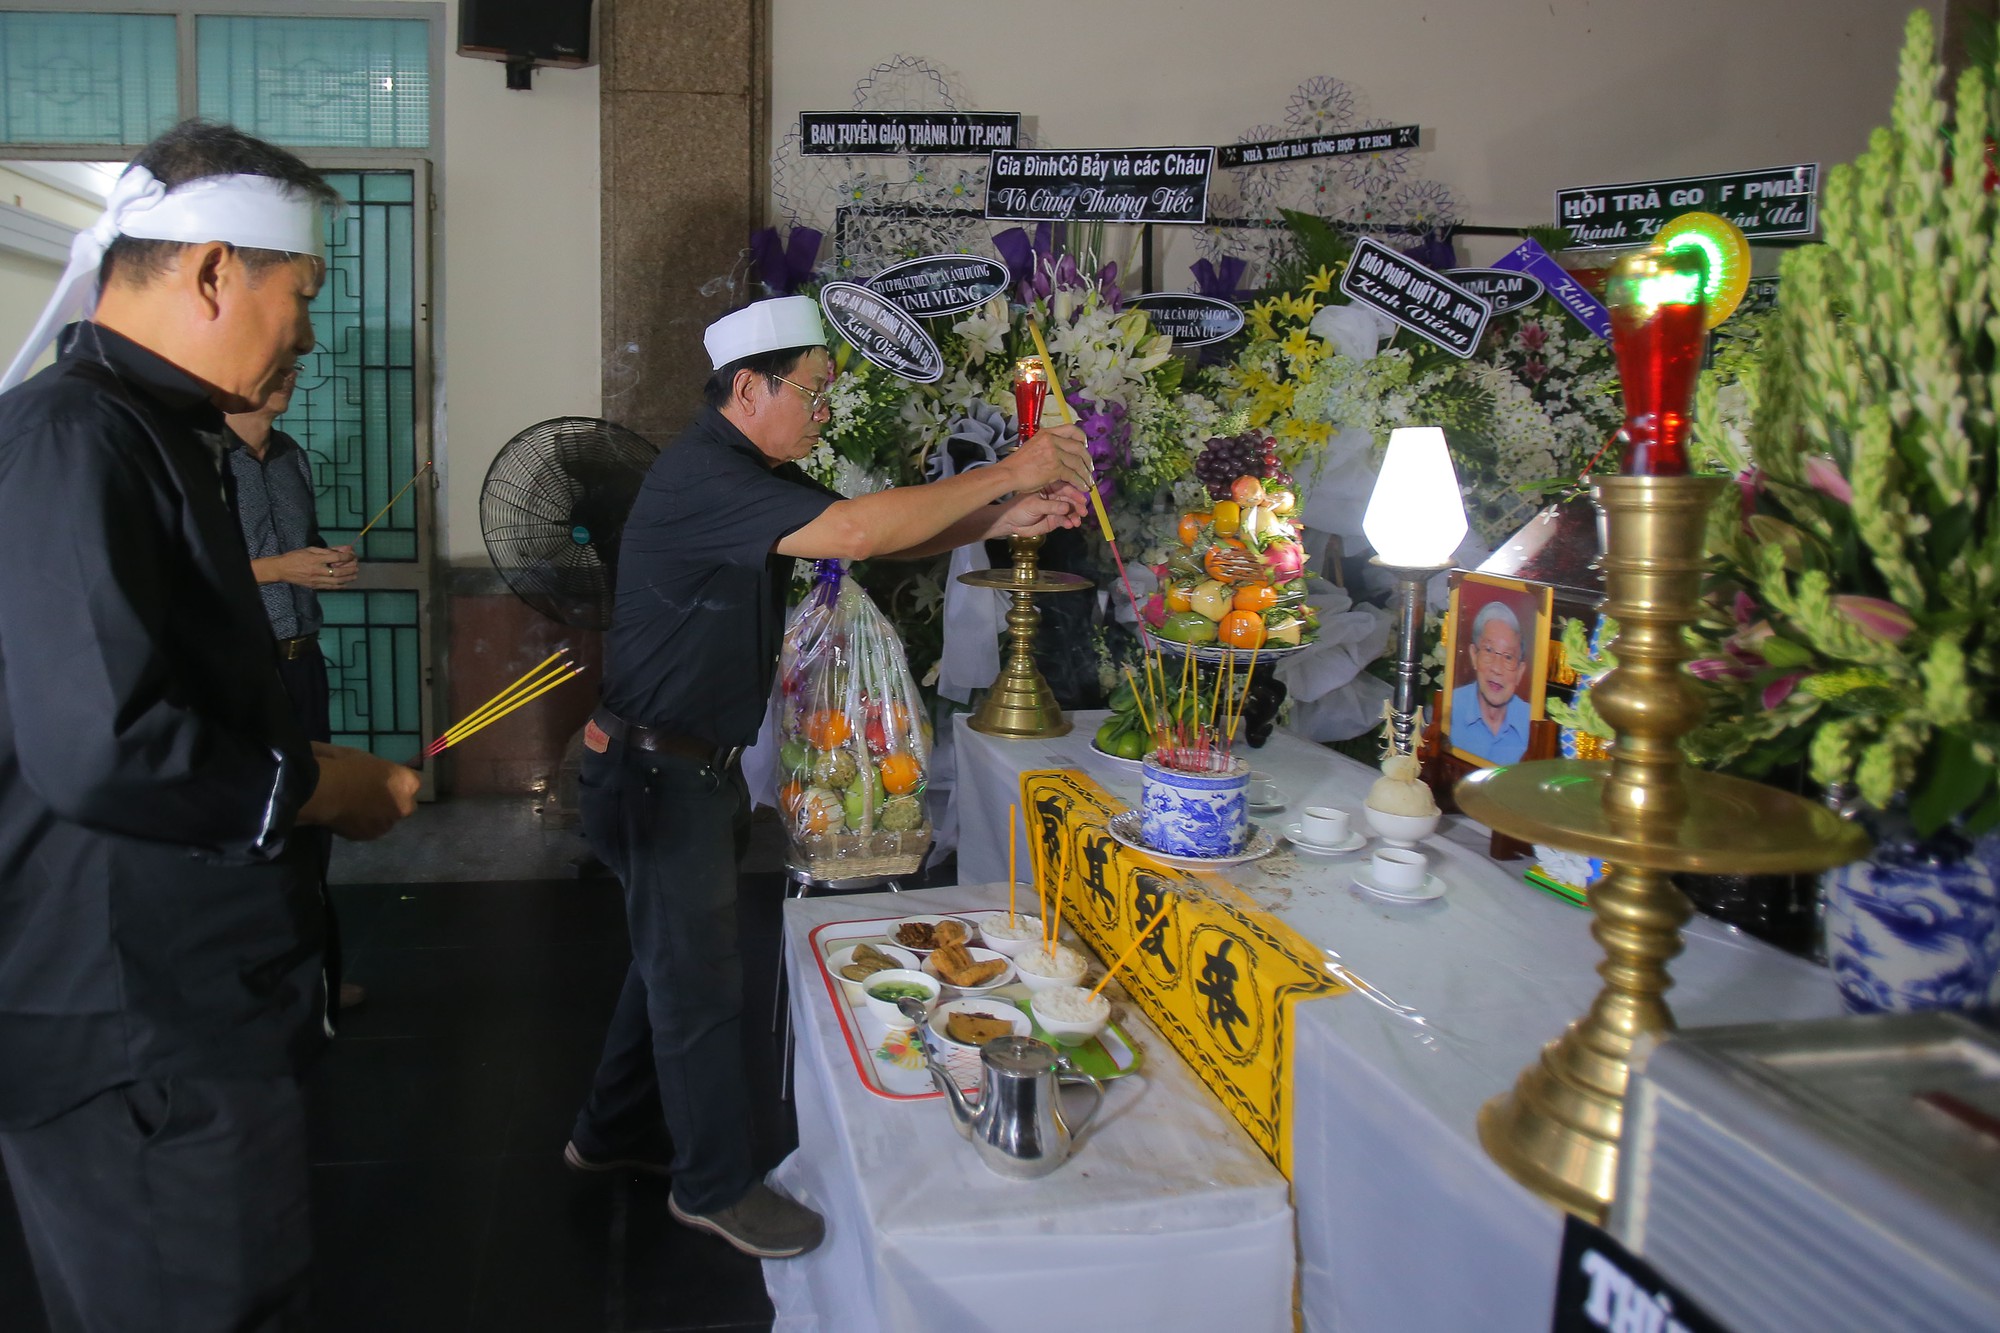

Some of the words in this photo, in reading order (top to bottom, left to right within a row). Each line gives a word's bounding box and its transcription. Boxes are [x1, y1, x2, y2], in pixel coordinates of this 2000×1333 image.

[811, 124, 835, 145] BAN
[838, 118, 876, 145] TUYÊN
[879, 119, 906, 145] GIÁO
[908, 119, 947, 145] THÀNH
[950, 117, 966, 146] ỦY
[968, 125, 1012, 146] TP.HCM
[1242, 145, 1263, 162] NHÀ
[1266, 141, 1289, 160] XUẤT
[1291, 139, 1309, 156] BẢN
[1312, 136, 1335, 154] TỔNG
[1337, 137, 1356, 153] HỢP
[996, 155, 1021, 176] Gia
[1081, 153, 1110, 181] Bảy
[1112, 154, 1130, 176] và
[1133, 153, 1160, 176] các
[1164, 152, 1205, 176] Cháu
[998, 188, 1027, 211] Vô
[1029, 188, 1077, 219] Cùng
[1080, 188, 1148, 219] Thương
[1152, 186, 1194, 213] Tiếc
[1564, 194, 1605, 217] HỘI
[1612, 188, 1661, 212] TRÀ
[1565, 220, 1627, 240] Thành
[1359, 251, 1384, 276] BÁO
[1380, 262, 1411, 289] PHÁP
[1405, 278, 1437, 304] LUẬT
[931, 283, 981, 306] VIẾNG
[1349, 274, 1400, 309] Kính
[1405, 304, 1468, 345] Viếng
[1550, 277, 1597, 319] Kính
[831, 290, 850, 307] CỤC
[897, 323, 913, 349] TRỊ
[841, 312, 872, 342] Kính
[873, 335, 908, 370] Viếng
